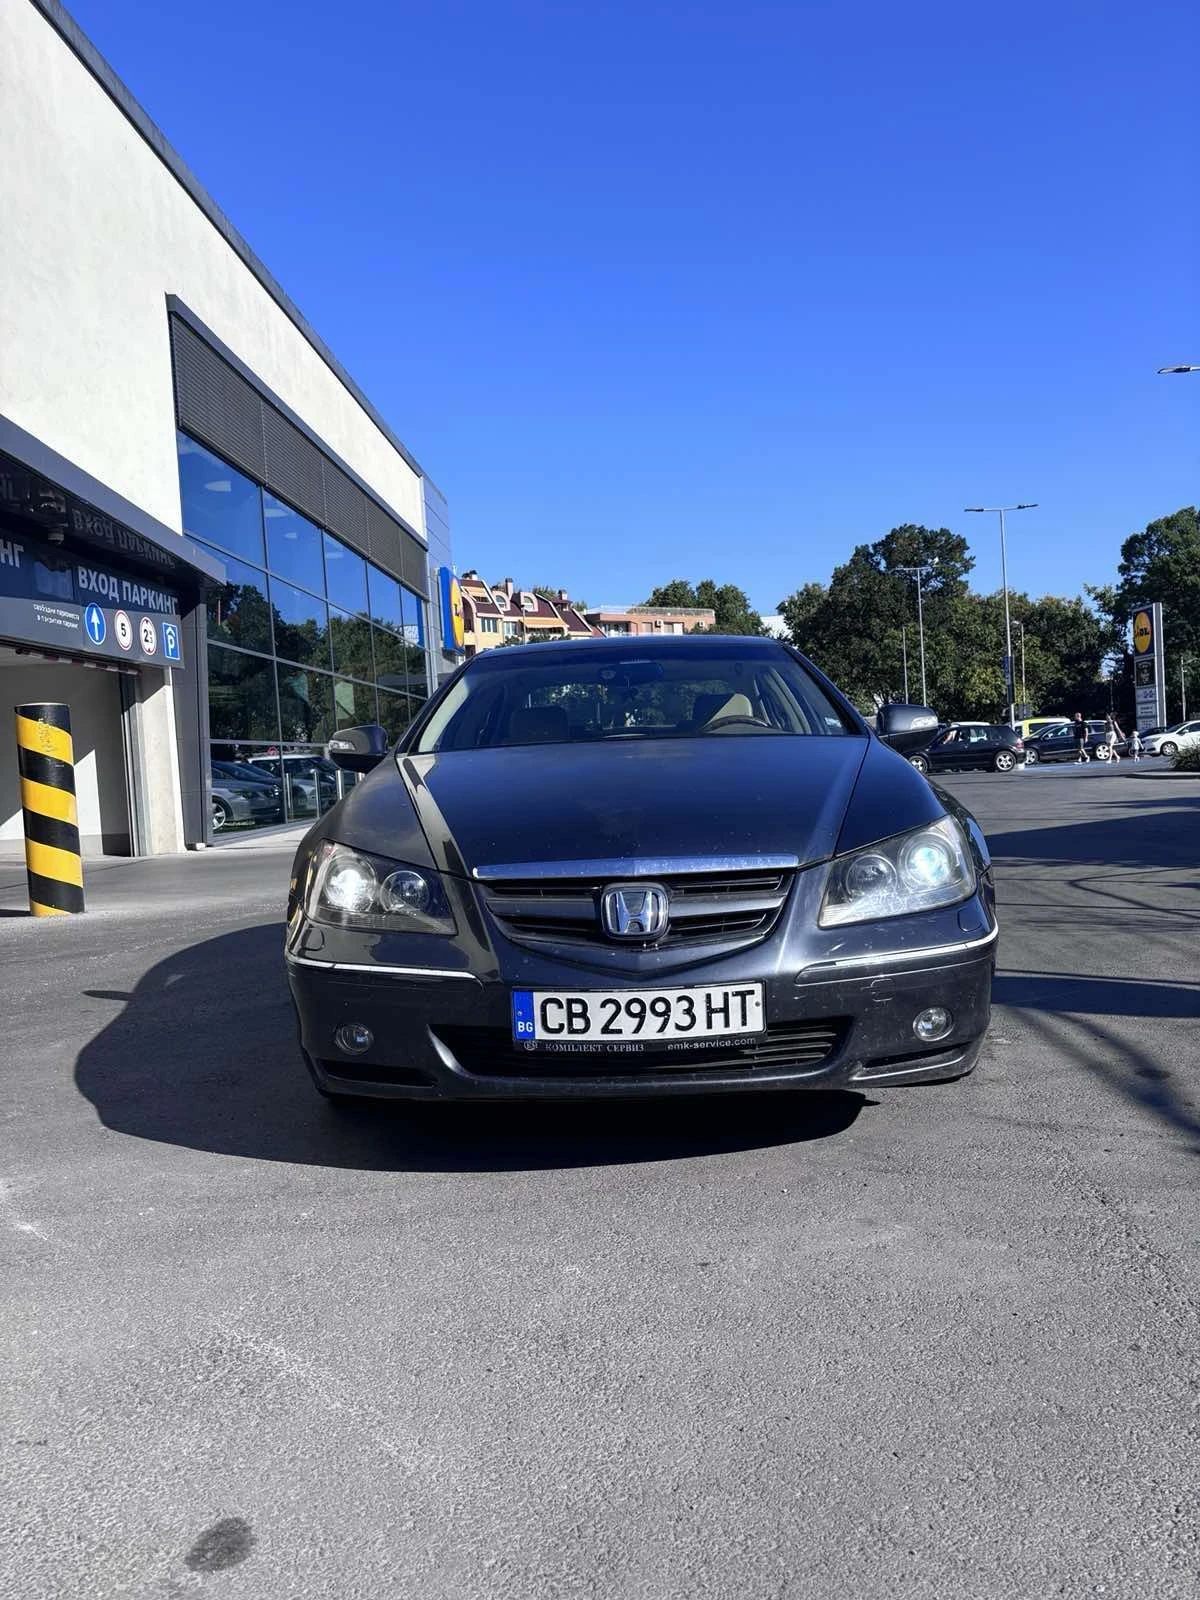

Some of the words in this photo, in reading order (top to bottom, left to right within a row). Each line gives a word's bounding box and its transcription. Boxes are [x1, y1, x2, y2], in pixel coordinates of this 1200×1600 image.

[78, 566, 120, 603] ВХОД
[122, 580, 178, 615] ПАРКИНГ
[121, 622, 127, 637] 5
[540, 997, 592, 1035] CB
[600, 994, 697, 1035] 2993
[705, 989, 755, 1030] HT
[517, 1021, 534, 1033] BG
[545, 1043, 602, 1053] КОМПЛЕКТ
[606, 1043, 645, 1053] СЕРВИЗ
[667, 1037, 756, 1051] emk-service.com
